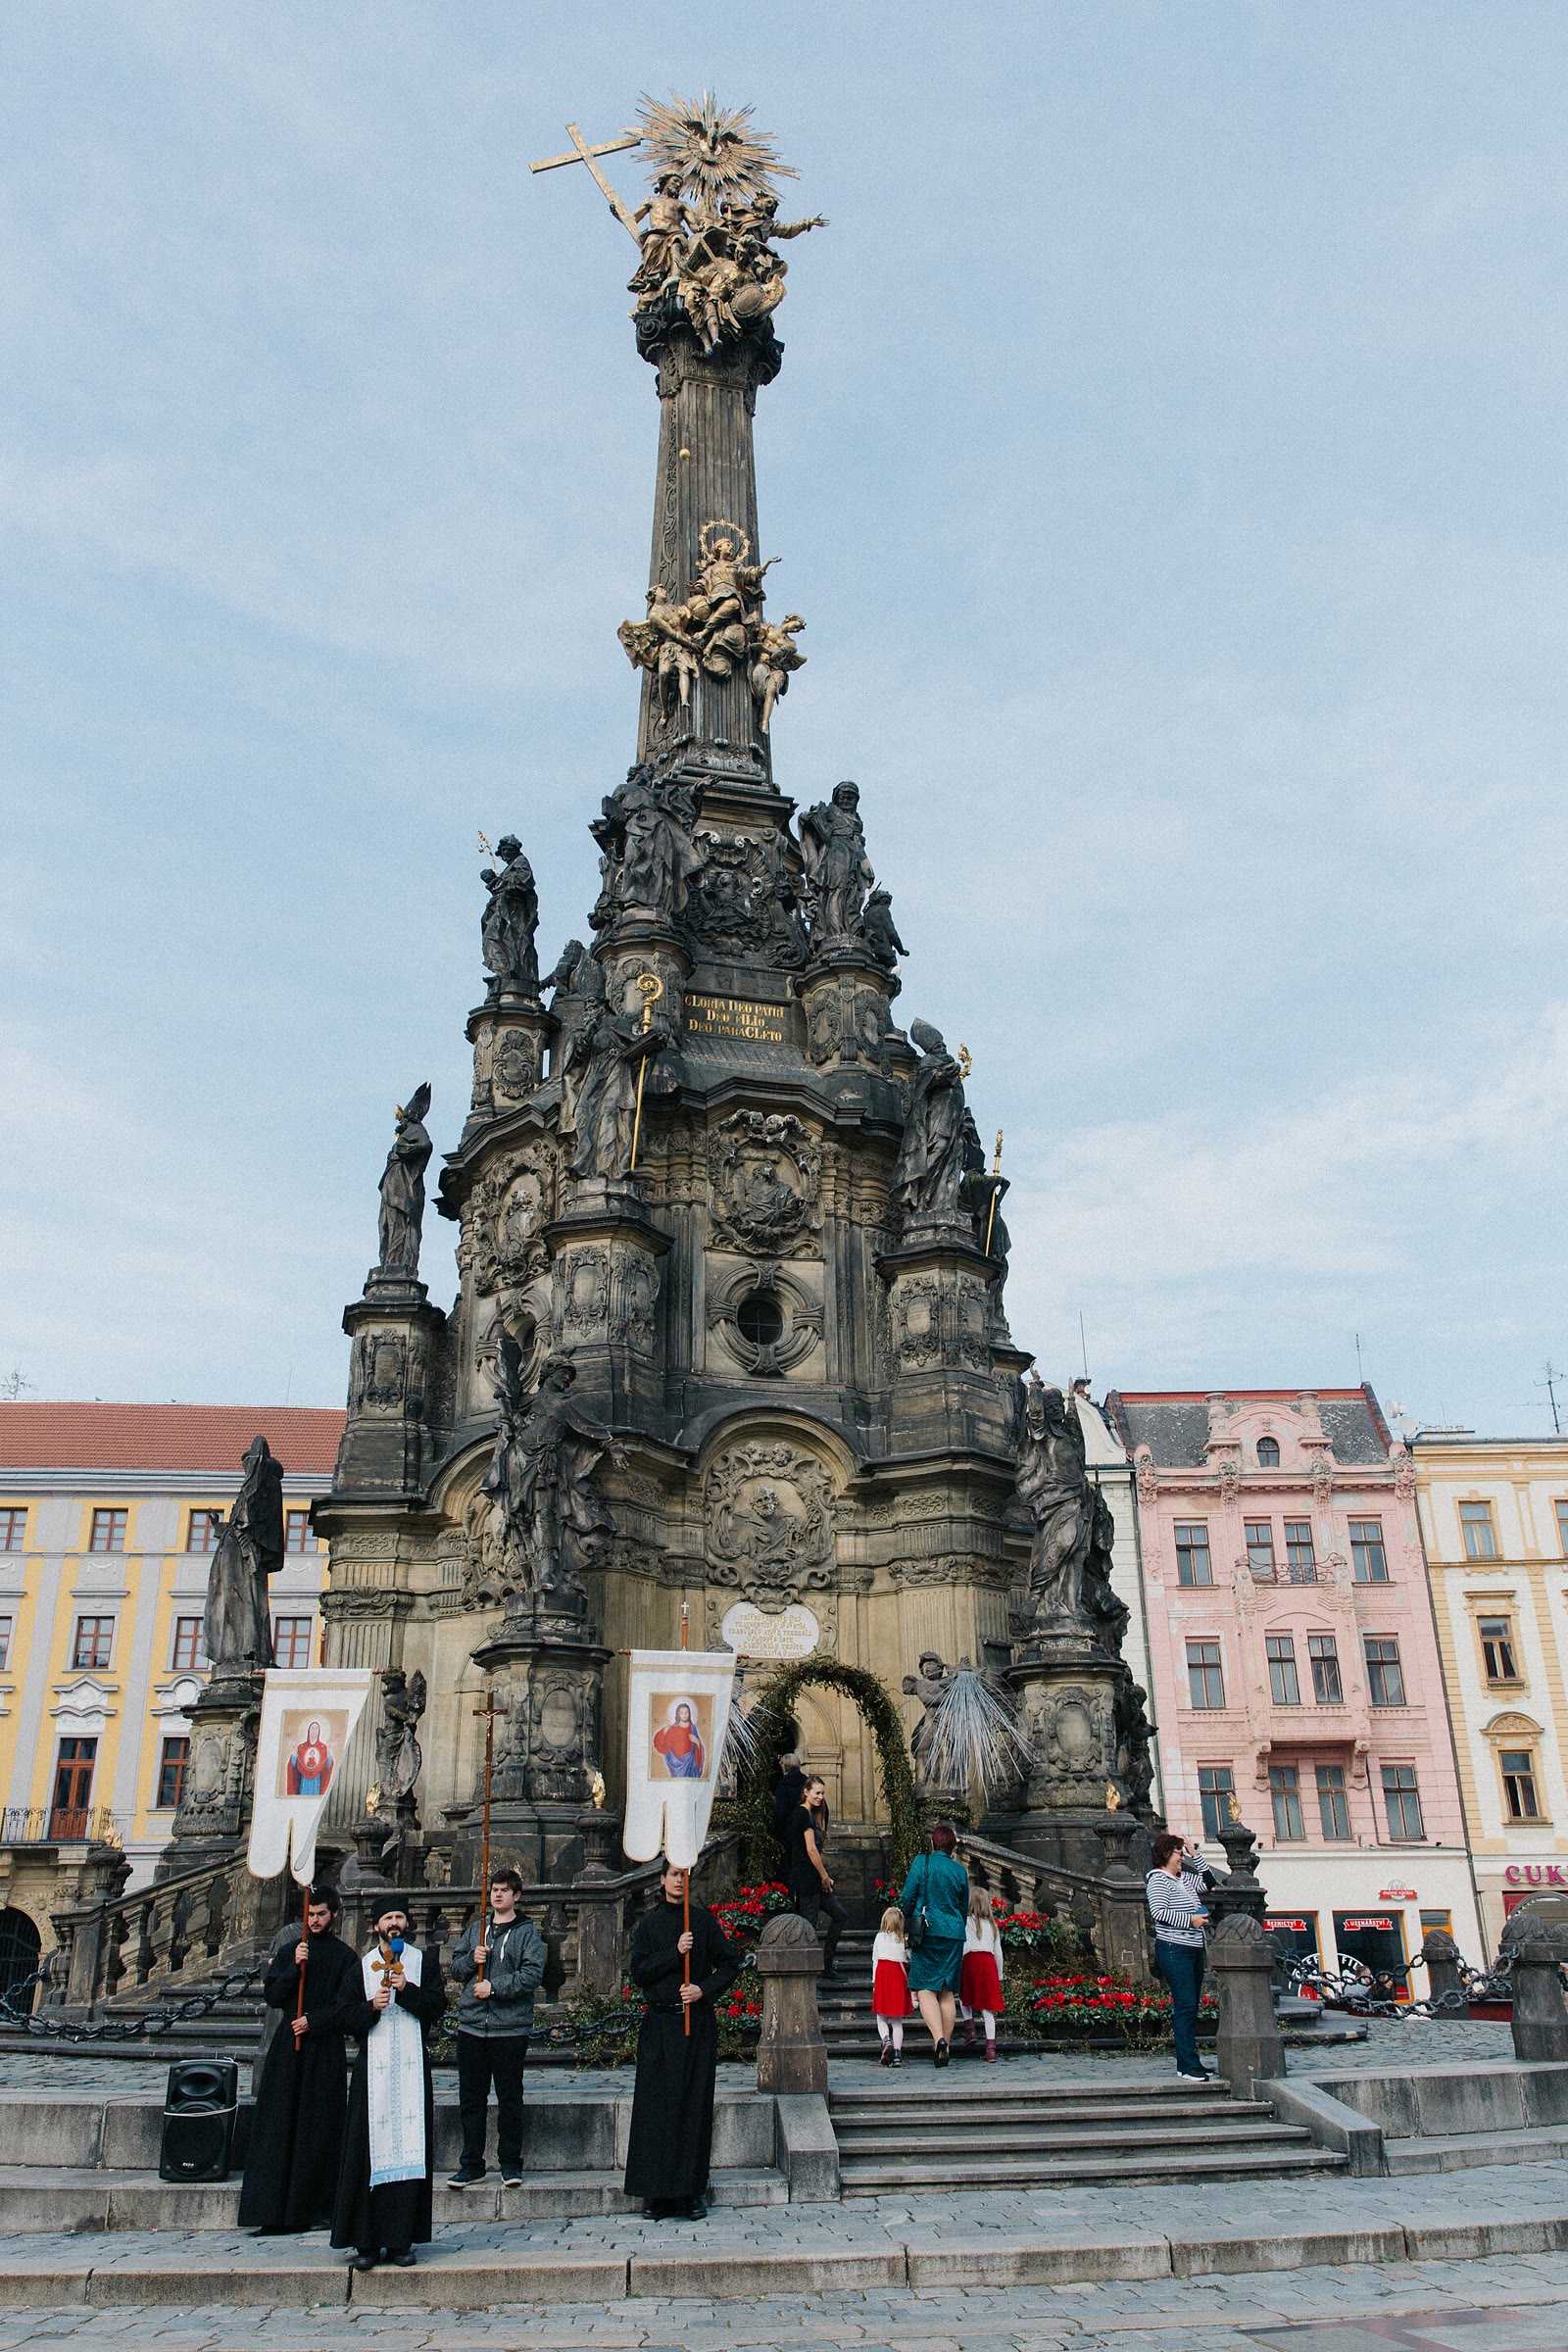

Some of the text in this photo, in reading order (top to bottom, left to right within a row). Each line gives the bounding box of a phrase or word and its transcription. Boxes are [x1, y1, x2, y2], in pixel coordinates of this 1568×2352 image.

[728, 1000, 753, 1014] DEO
[707, 1008, 730, 1023] DEO
[688, 1018, 712, 1033] DEO
[1505, 1865, 1568, 1885] CUK
